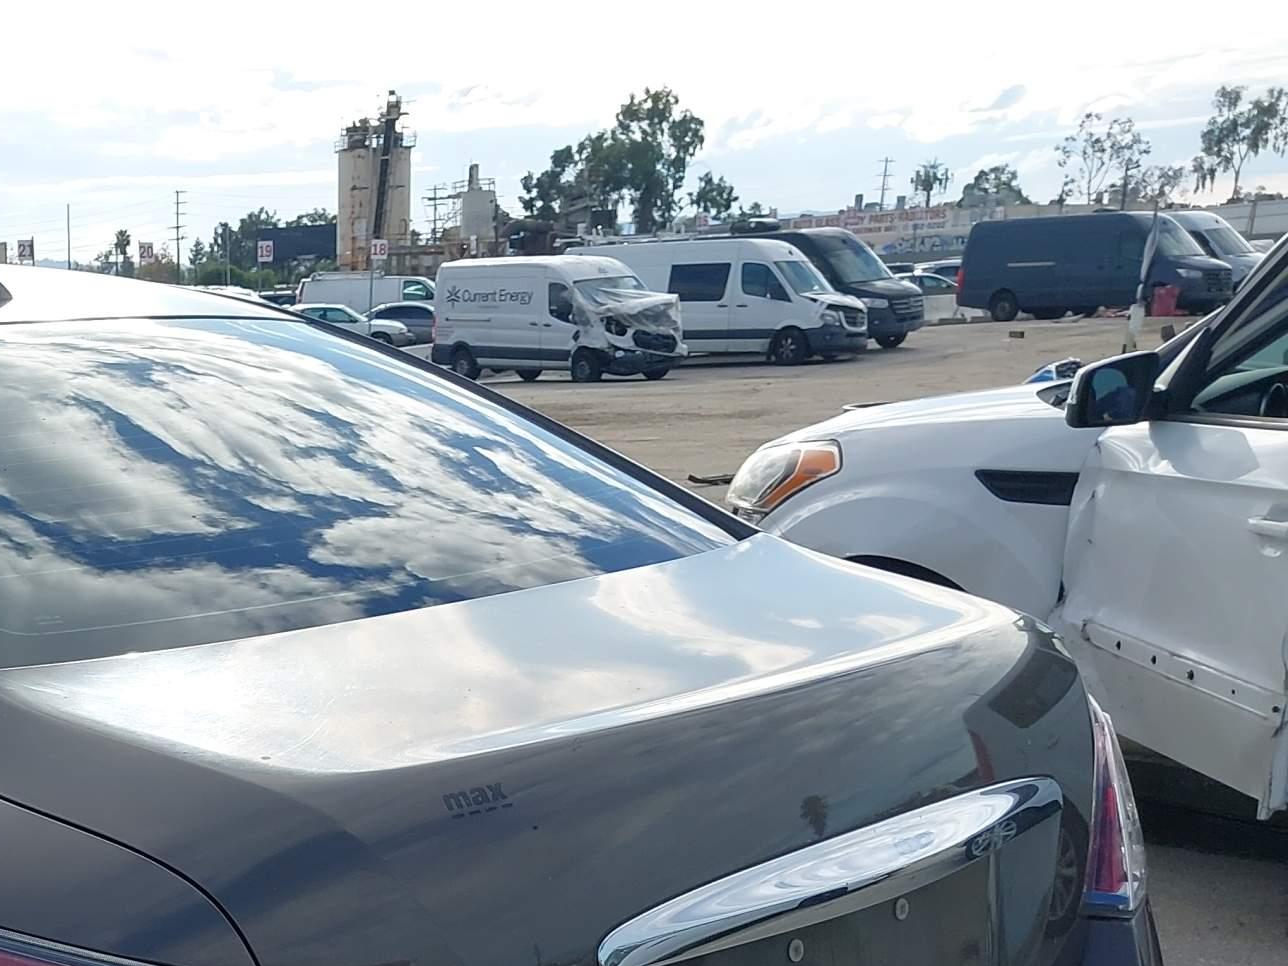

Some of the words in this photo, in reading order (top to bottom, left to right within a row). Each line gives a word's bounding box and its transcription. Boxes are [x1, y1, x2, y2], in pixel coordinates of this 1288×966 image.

[18, 243, 33, 257] 21
[139, 246, 153, 259] 20
[259, 245, 272, 258] 19
[372, 243, 386, 256] 18
[462, 288, 497, 303] Current
[498, 288, 534, 305] Energy
[442, 781, 509, 812] max
